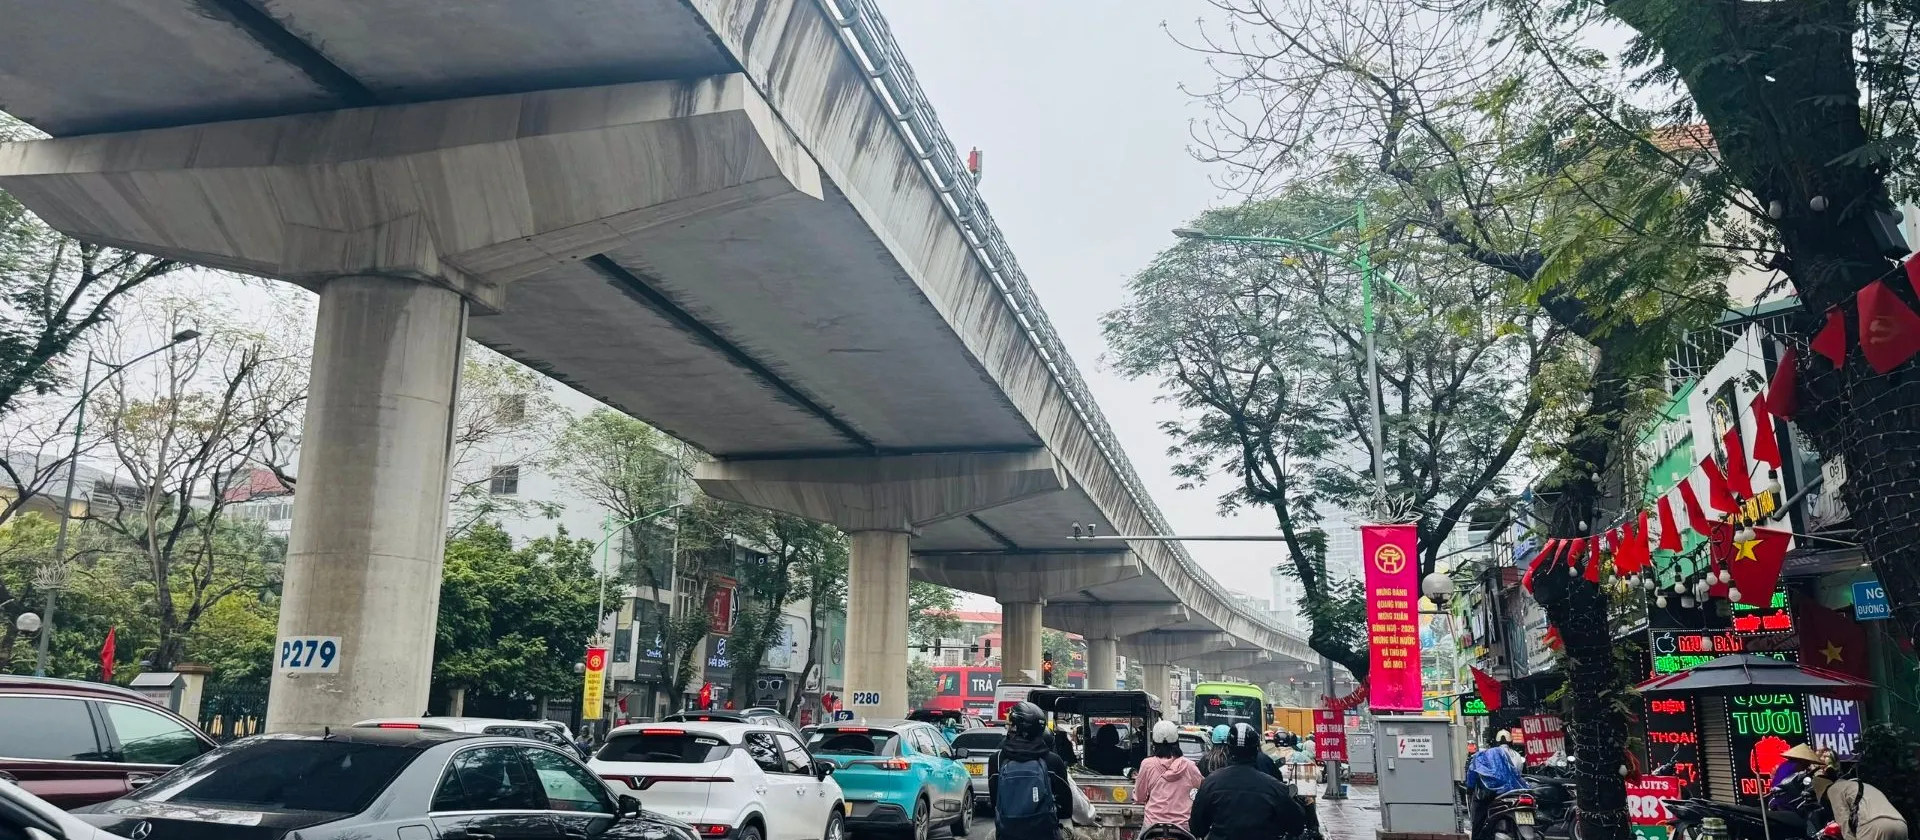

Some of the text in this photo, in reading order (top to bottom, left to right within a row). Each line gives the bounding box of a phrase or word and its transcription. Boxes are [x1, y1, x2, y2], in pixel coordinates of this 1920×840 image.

[1376, 599, 1408, 609] QUANG VINH
[1678, 636, 1713, 652] MU
[280, 639, 337, 669] P279
[971, 673, 994, 692] TRẢ
[853, 692, 880, 705] P280
[1523, 718, 1542, 734] CHO
[1732, 708, 1803, 734] TƯƠI
[1320, 737, 1341, 747] LAPTOP
[1648, 731, 1695, 746] THOẠI
[1331, 750, 1342, 760] CAO
